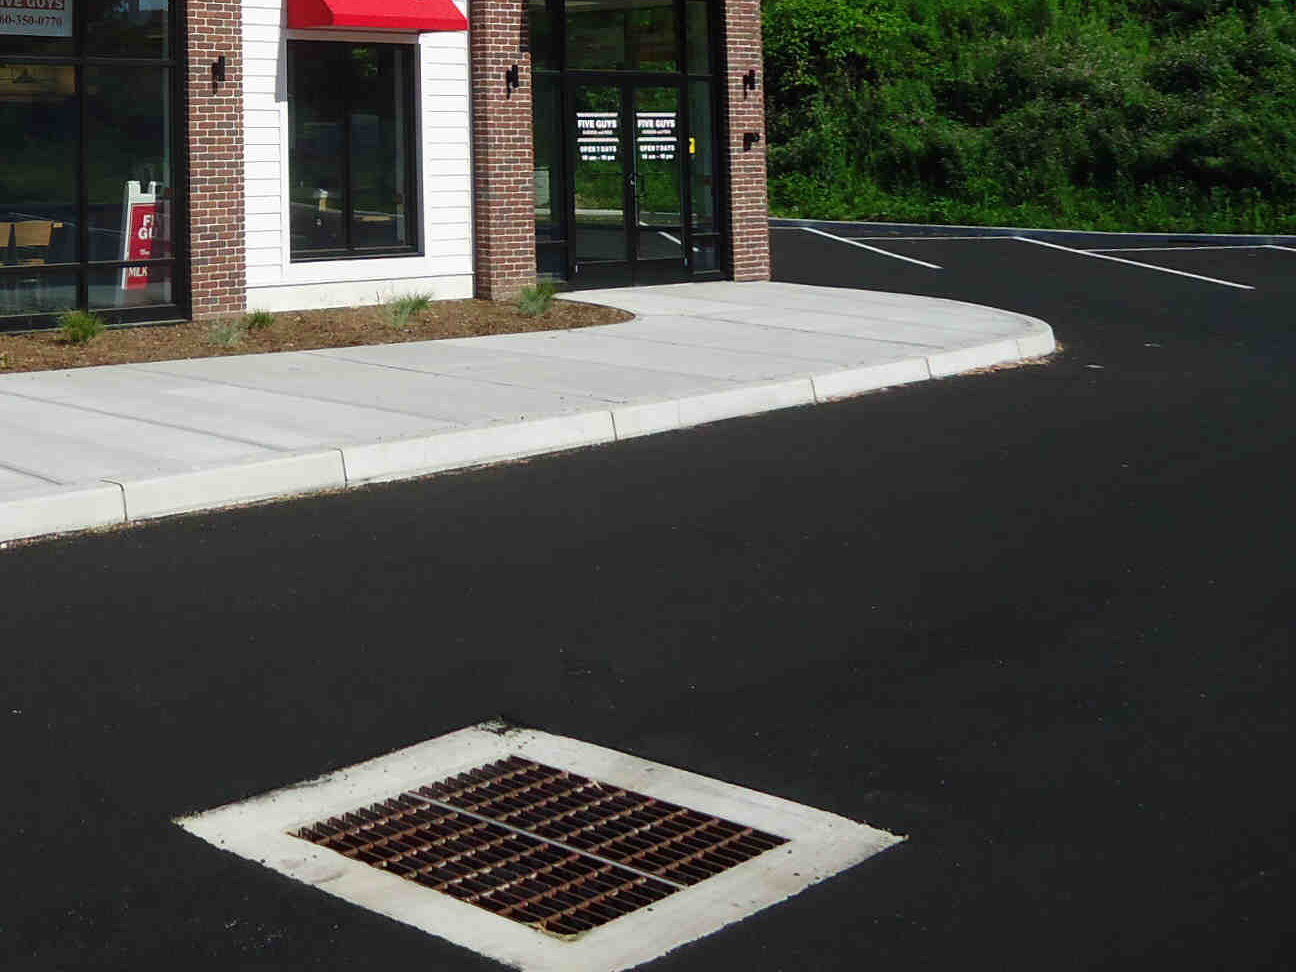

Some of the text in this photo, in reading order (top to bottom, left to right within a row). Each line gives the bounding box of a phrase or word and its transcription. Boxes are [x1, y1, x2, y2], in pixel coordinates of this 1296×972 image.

[577, 119, 617, 129] FIVE GUYS
[637, 119, 676, 128] FIVE GUYS
